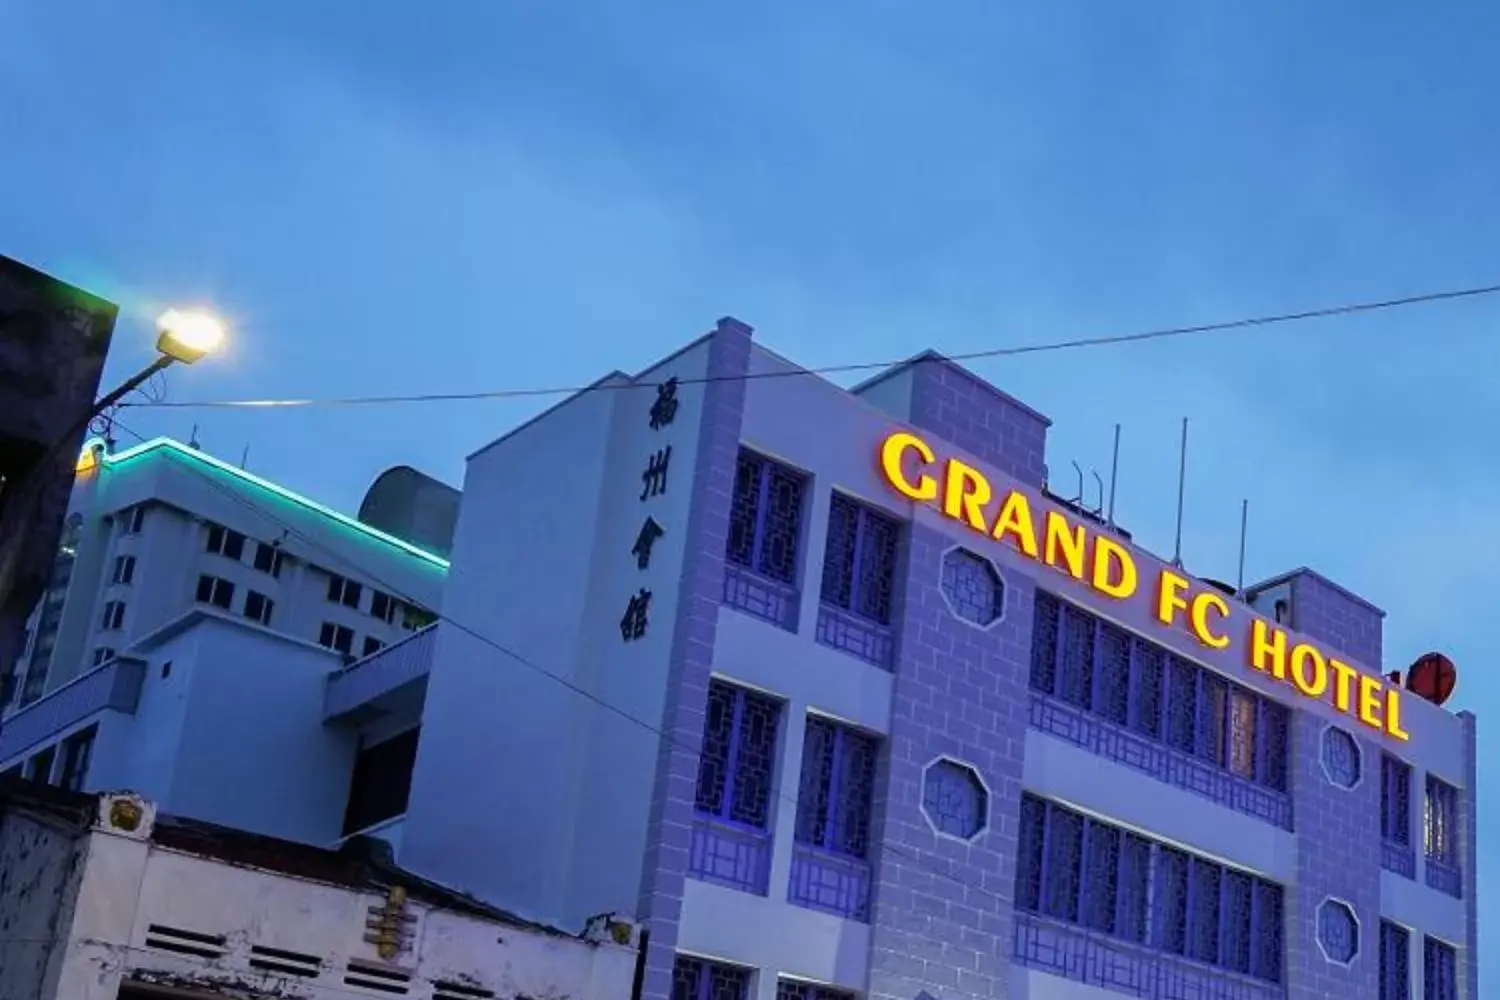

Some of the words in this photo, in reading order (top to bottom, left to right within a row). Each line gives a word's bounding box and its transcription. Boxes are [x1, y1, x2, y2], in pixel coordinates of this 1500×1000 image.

[880, 431, 1138, 600] GRAND
[1157, 569, 1231, 649] FC
[1249, 617, 1411, 741] HOTEL
